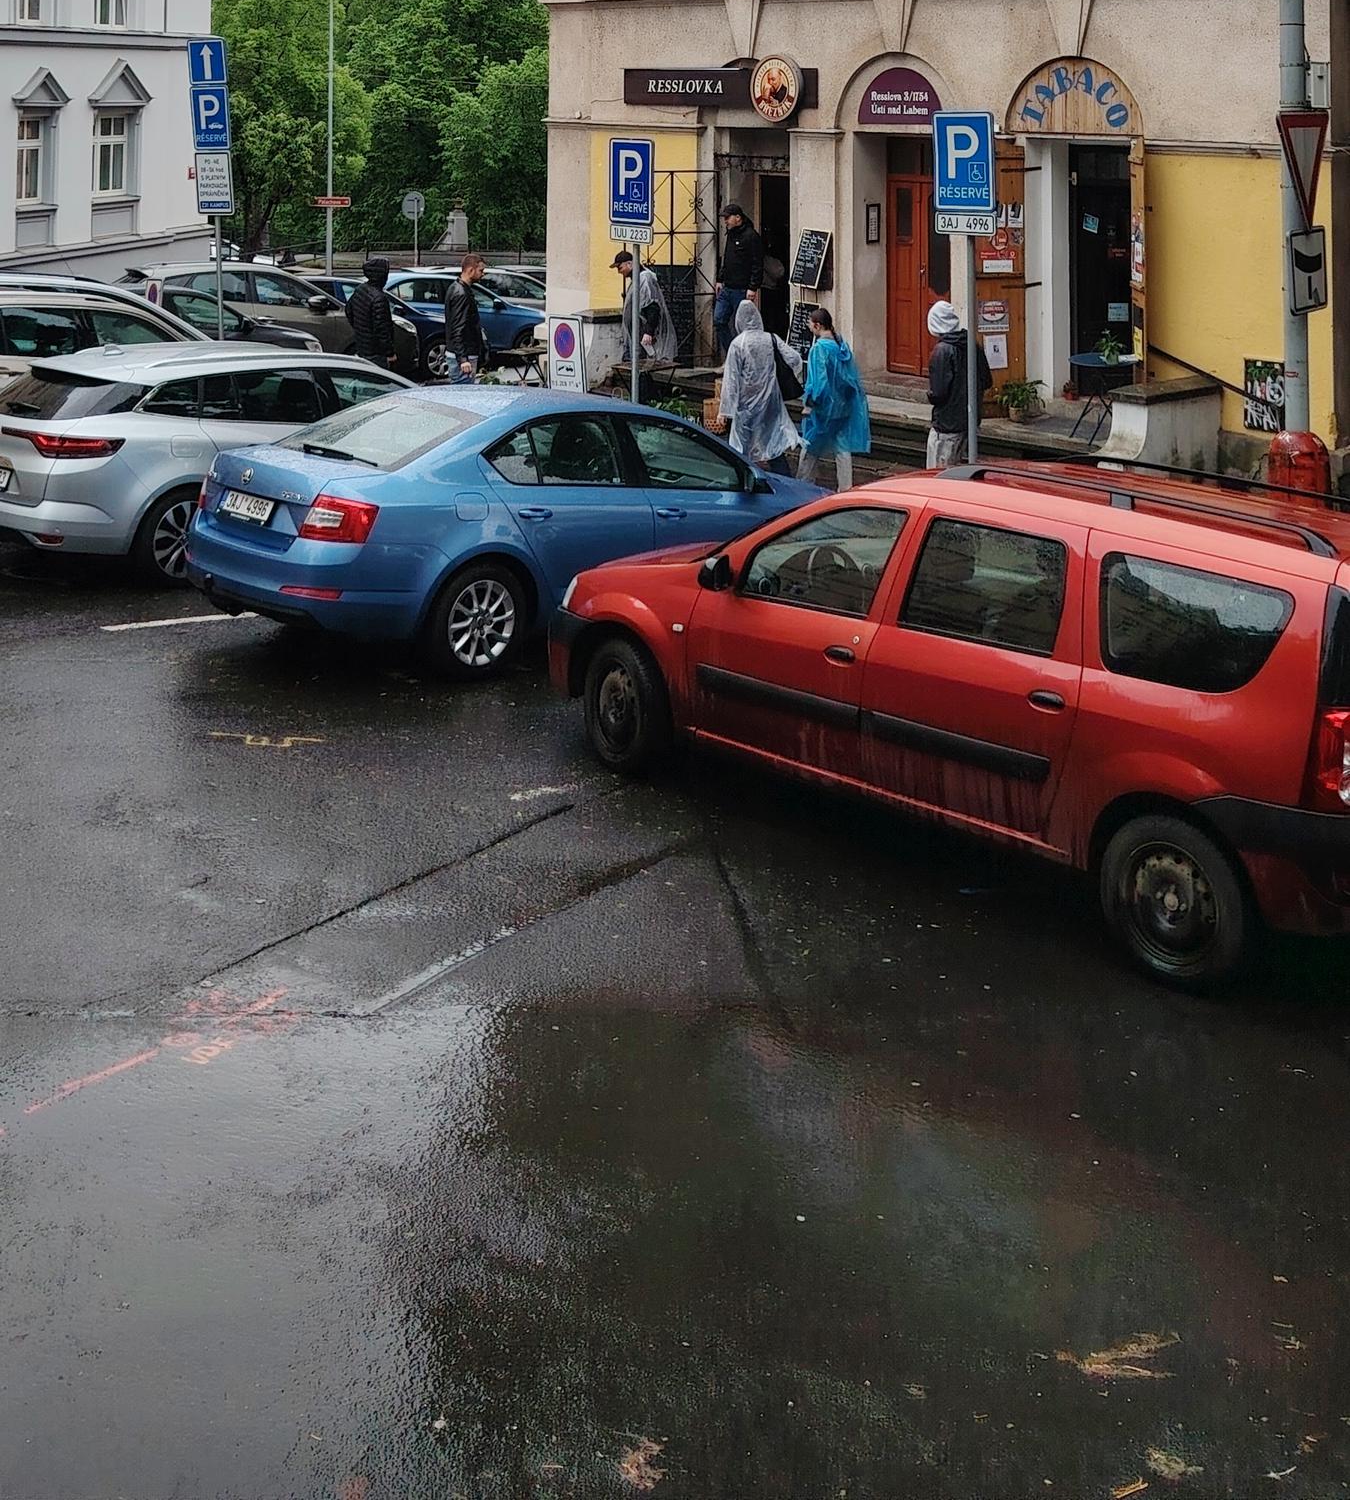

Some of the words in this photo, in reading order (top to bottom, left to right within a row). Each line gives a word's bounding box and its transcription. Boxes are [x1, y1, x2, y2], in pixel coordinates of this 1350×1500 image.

[647, 79, 724, 94] RESSLOVKA
[870, 90, 902, 101] Resslova
[903, 90, 929, 102] 3/1754
[1016, 66, 1129, 128] TABACO
[198, 94, 220, 130] P
[870, 102, 886, 114] Ústí
[887, 104, 902, 115] nad
[903, 104, 929, 115] Labem
[196, 132, 228, 143] RÉSERVÉ
[946, 125, 980, 179] P
[619, 149, 643, 196] P
[940, 184, 990, 199] RÉSERVÉ
[613, 200, 648, 214] RÉSERVÉ
[940, 216, 959, 229] 3AJ
[966, 217, 989, 231] 4996
[613, 227, 628, 238] 1UU
[629, 228, 648, 241] 2233
[226, 493, 244, 511] 3AJ
[246, 499, 269, 517] 4996
